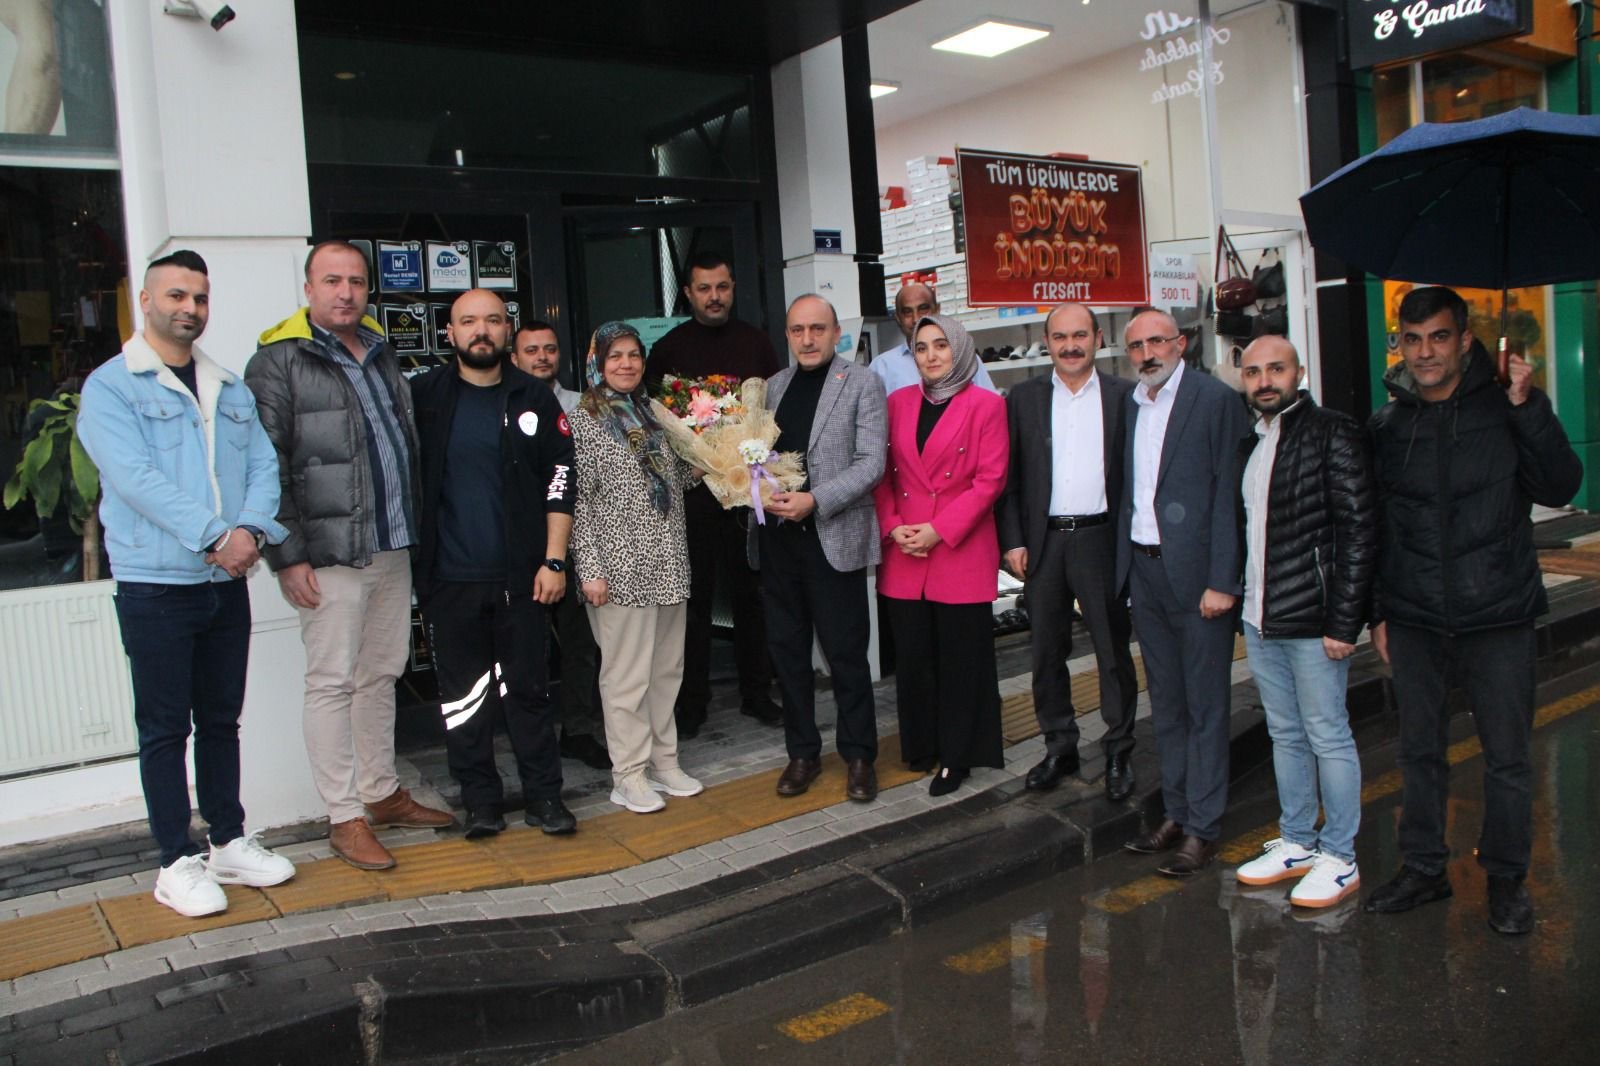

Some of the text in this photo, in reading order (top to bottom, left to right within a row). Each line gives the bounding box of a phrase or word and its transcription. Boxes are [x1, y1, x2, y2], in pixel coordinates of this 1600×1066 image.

[1373, 0, 1486, 40] & Çanta
[986, 160, 1119, 192] TÜM ÜRÜNLERDE
[1009, 187, 1108, 234] BÜYÜK
[825, 238, 832, 248] 3
[993, 233, 1121, 280] İNDİRİM
[1165, 257, 1183, 266] SPOR
[1033, 282, 1091, 300] FIRSATI
[1161, 287, 1191, 301] 500 TL
